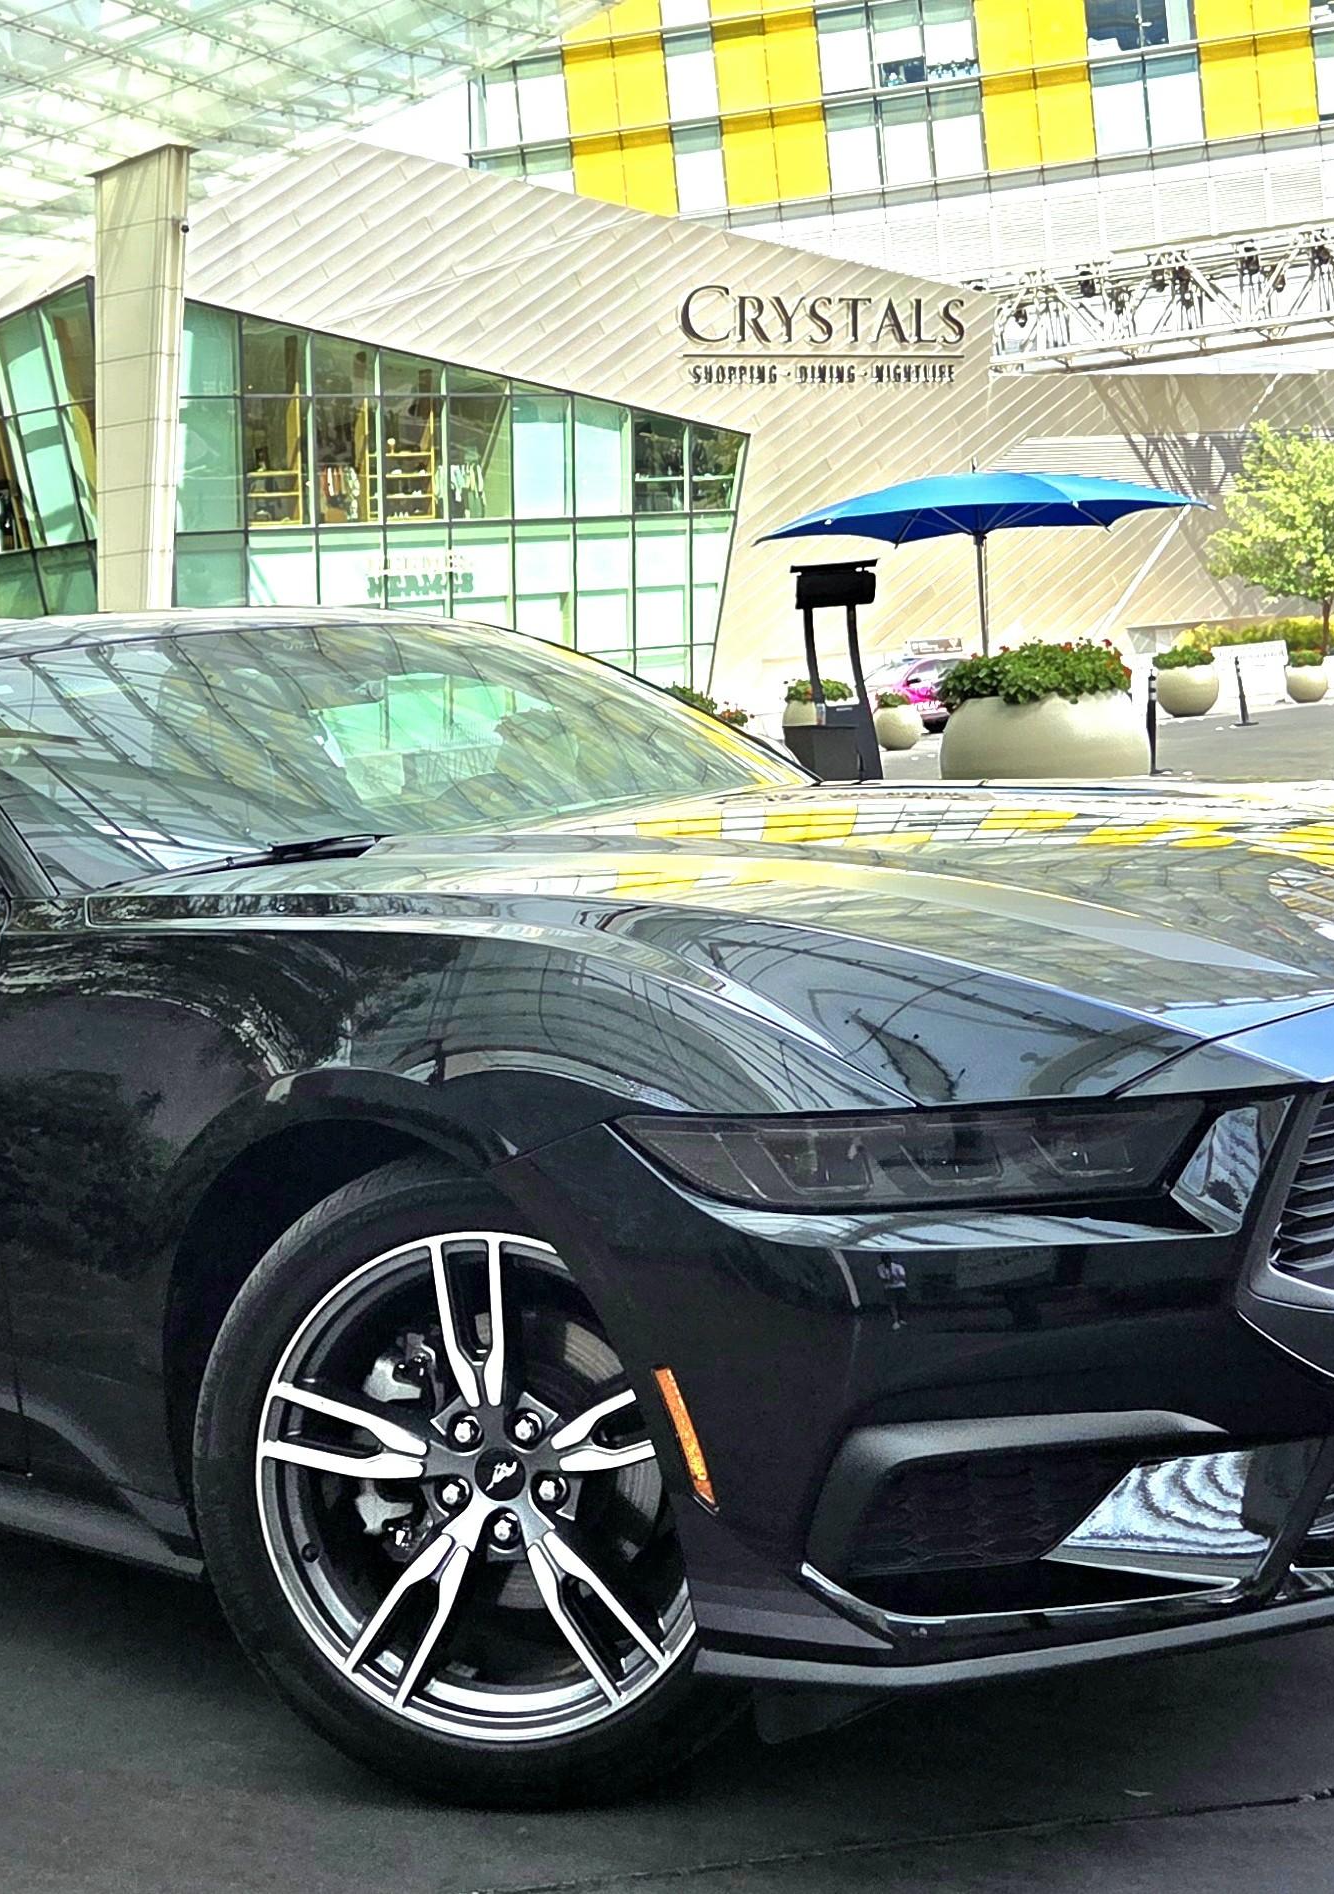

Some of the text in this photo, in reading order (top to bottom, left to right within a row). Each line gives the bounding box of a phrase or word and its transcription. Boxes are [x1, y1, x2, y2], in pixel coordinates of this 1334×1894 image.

[680, 285, 965, 343] CRYSTALS
[691, 364, 955, 384] SHOPPING DINING NIGHTLIFE
